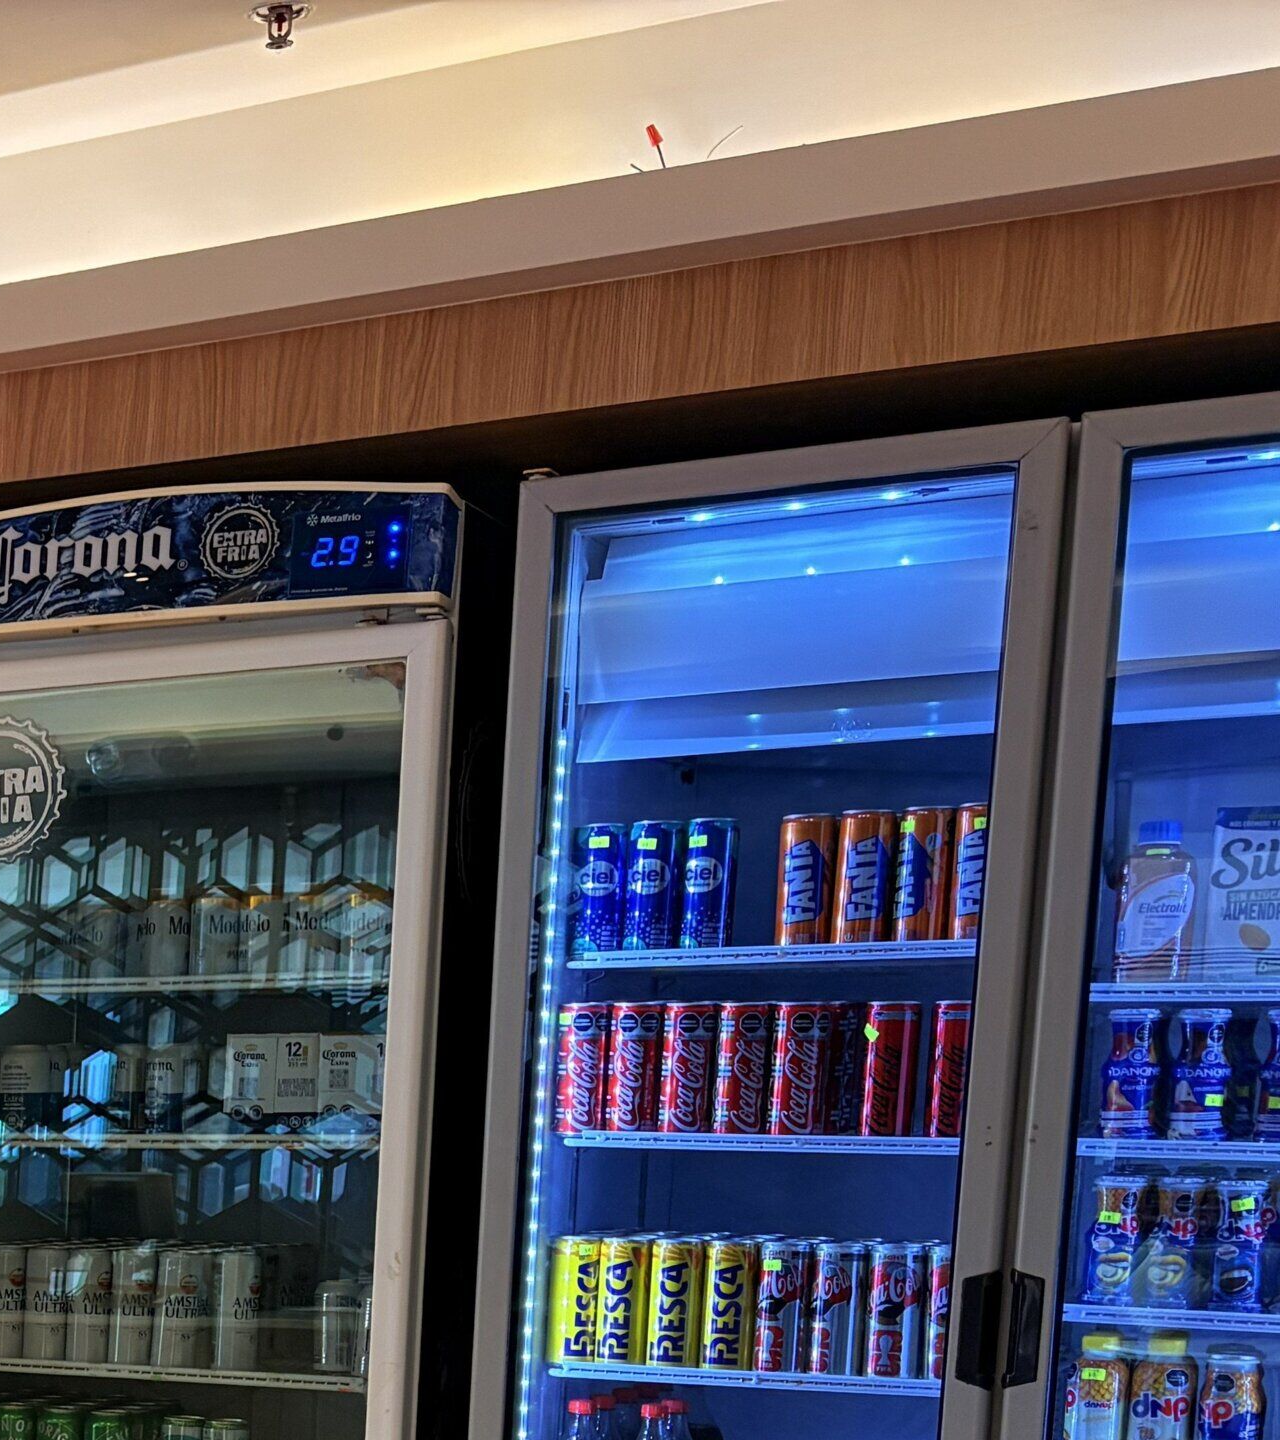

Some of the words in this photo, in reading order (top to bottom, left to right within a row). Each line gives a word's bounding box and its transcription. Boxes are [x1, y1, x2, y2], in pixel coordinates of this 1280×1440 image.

[320, 512, 362, 525] Metalfrio
[212, 528, 268, 549] EXTRA
[216, 546, 260, 564] FRIA
[310, 535, 360, 568] 2.9
[580, 868, 615, 885] ciel
[631, 866, 667, 883] ciel
[685, 865, 718, 882] ciel
[845, 835, 879, 921] FANTA
[957, 829, 985, 916] FANTA
[1210, 837, 1280, 890] Sil
[784, 839, 817, 925] FANTA
[1138, 901, 1188, 914] Electrolit
[233, 1051, 268, 1062] Corona
[285, 1042, 303, 1057] 12
[321, 1049, 358, 1061] Corona
[668, 1037, 706, 1132] Coca-Cola
[729, 1037, 766, 1133] Coca-Cola
[780, 1036, 819, 1135] Coca-Cola
[596, 1259, 634, 1361] FRESCA
[649, 1261, 689, 1363] FRESCA
[702, 1263, 745, 1366] FRESCA
